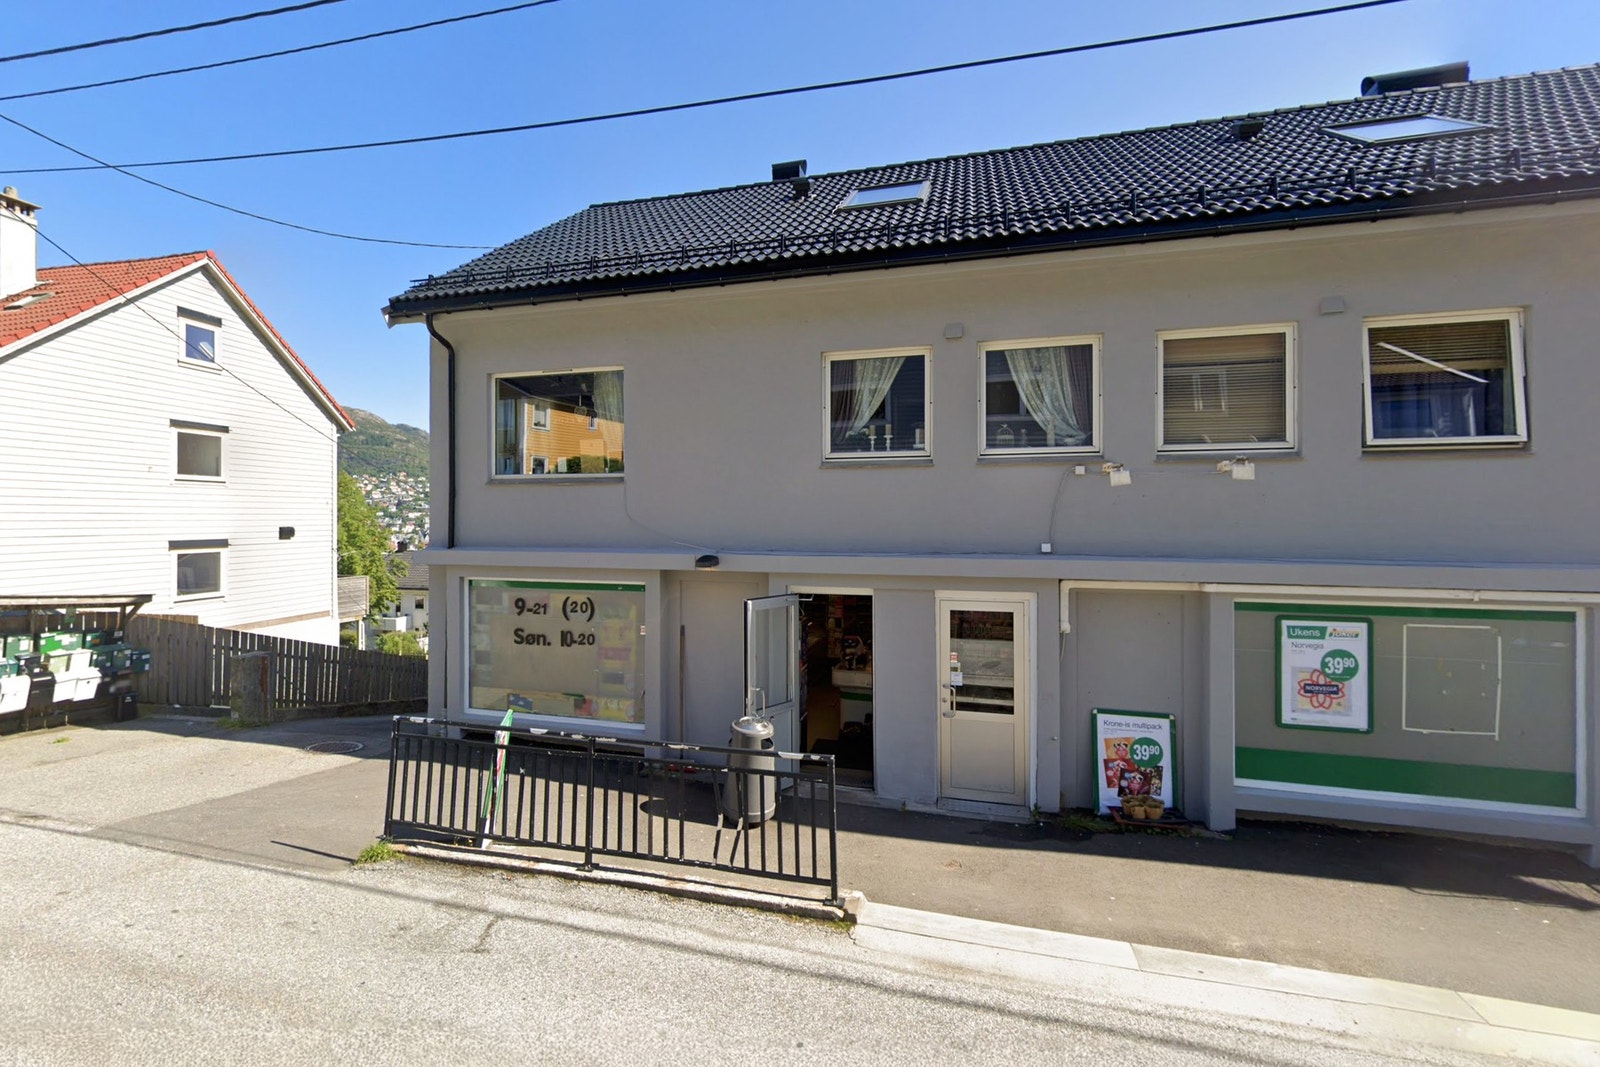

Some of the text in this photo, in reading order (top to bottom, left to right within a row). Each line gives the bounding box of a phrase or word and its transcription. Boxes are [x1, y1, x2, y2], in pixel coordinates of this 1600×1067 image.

[514, 596, 595, 622] 9-21 (20)
[513, 627, 595, 647] Søn. 10-20
[1289, 628, 1321, 638] Ukens
[1291, 641, 1324, 650] Norvegia
[1103, 720, 1131, 728] Krone-is
[1132, 722, 1162, 730] multipack
